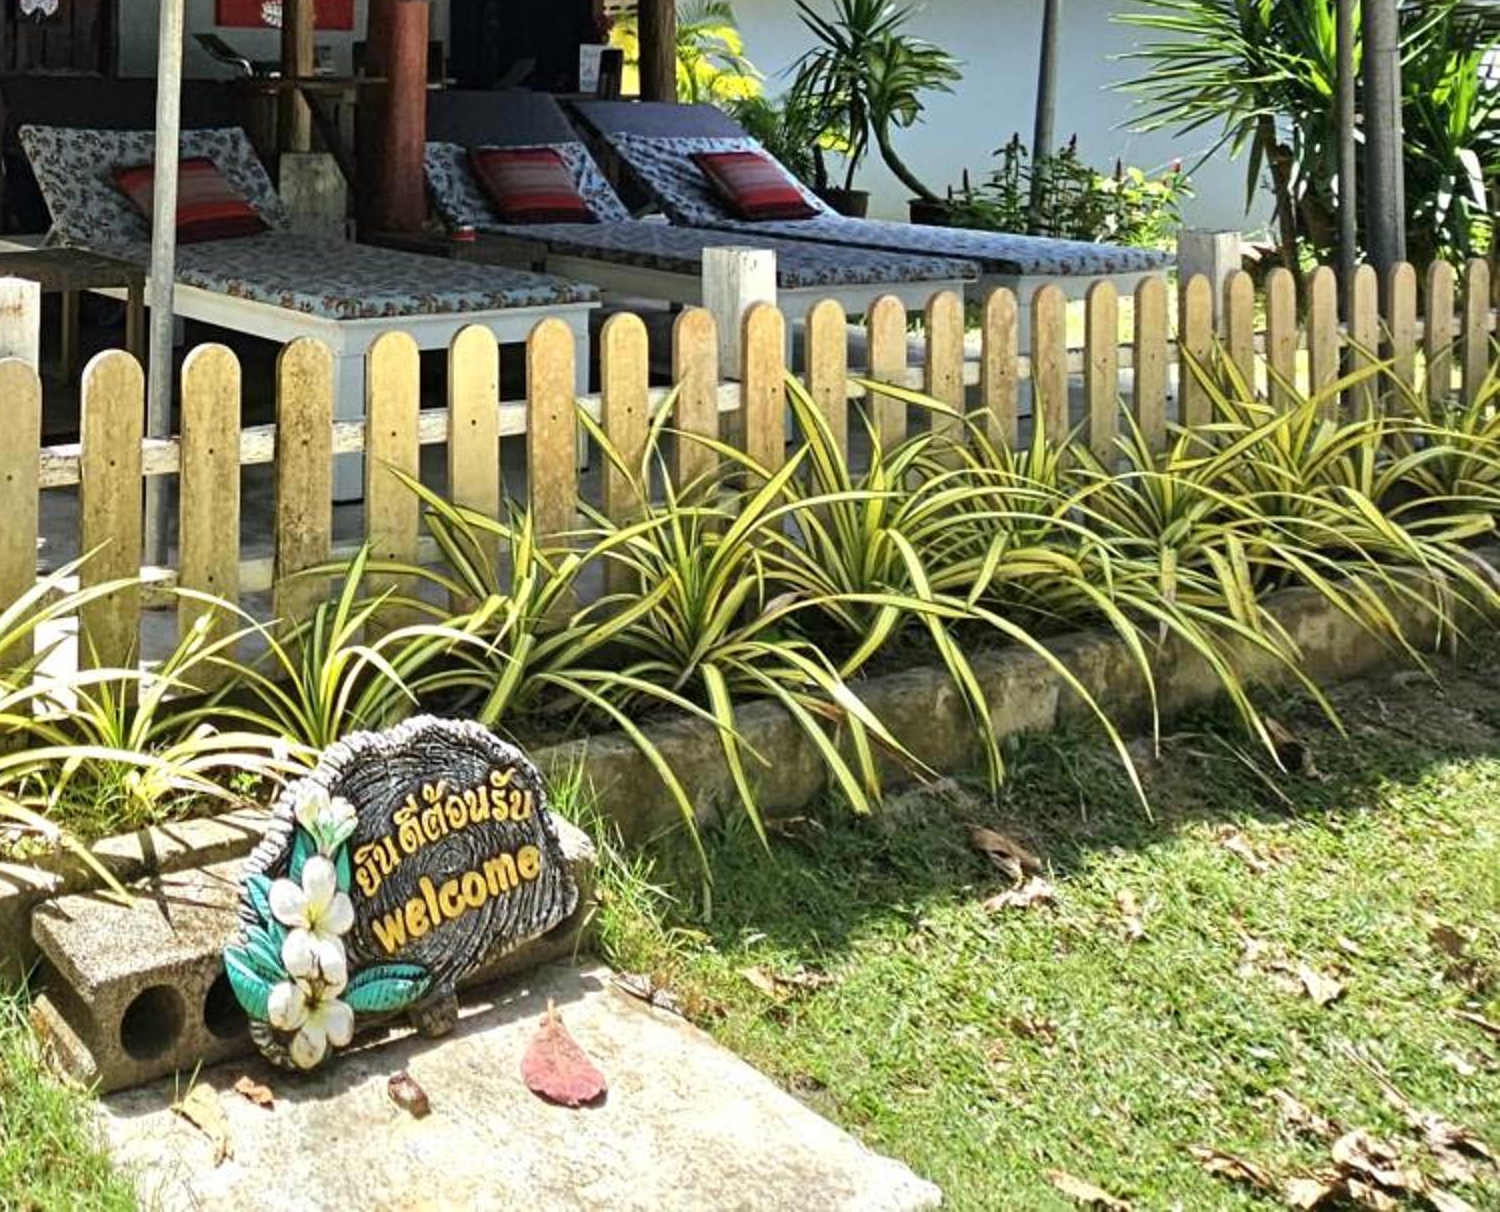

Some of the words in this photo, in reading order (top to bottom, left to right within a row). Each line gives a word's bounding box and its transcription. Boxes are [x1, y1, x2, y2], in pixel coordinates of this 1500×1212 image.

[354, 767, 533, 897] ยินดีต้อนรับ
[372, 845, 541, 955] welcome
